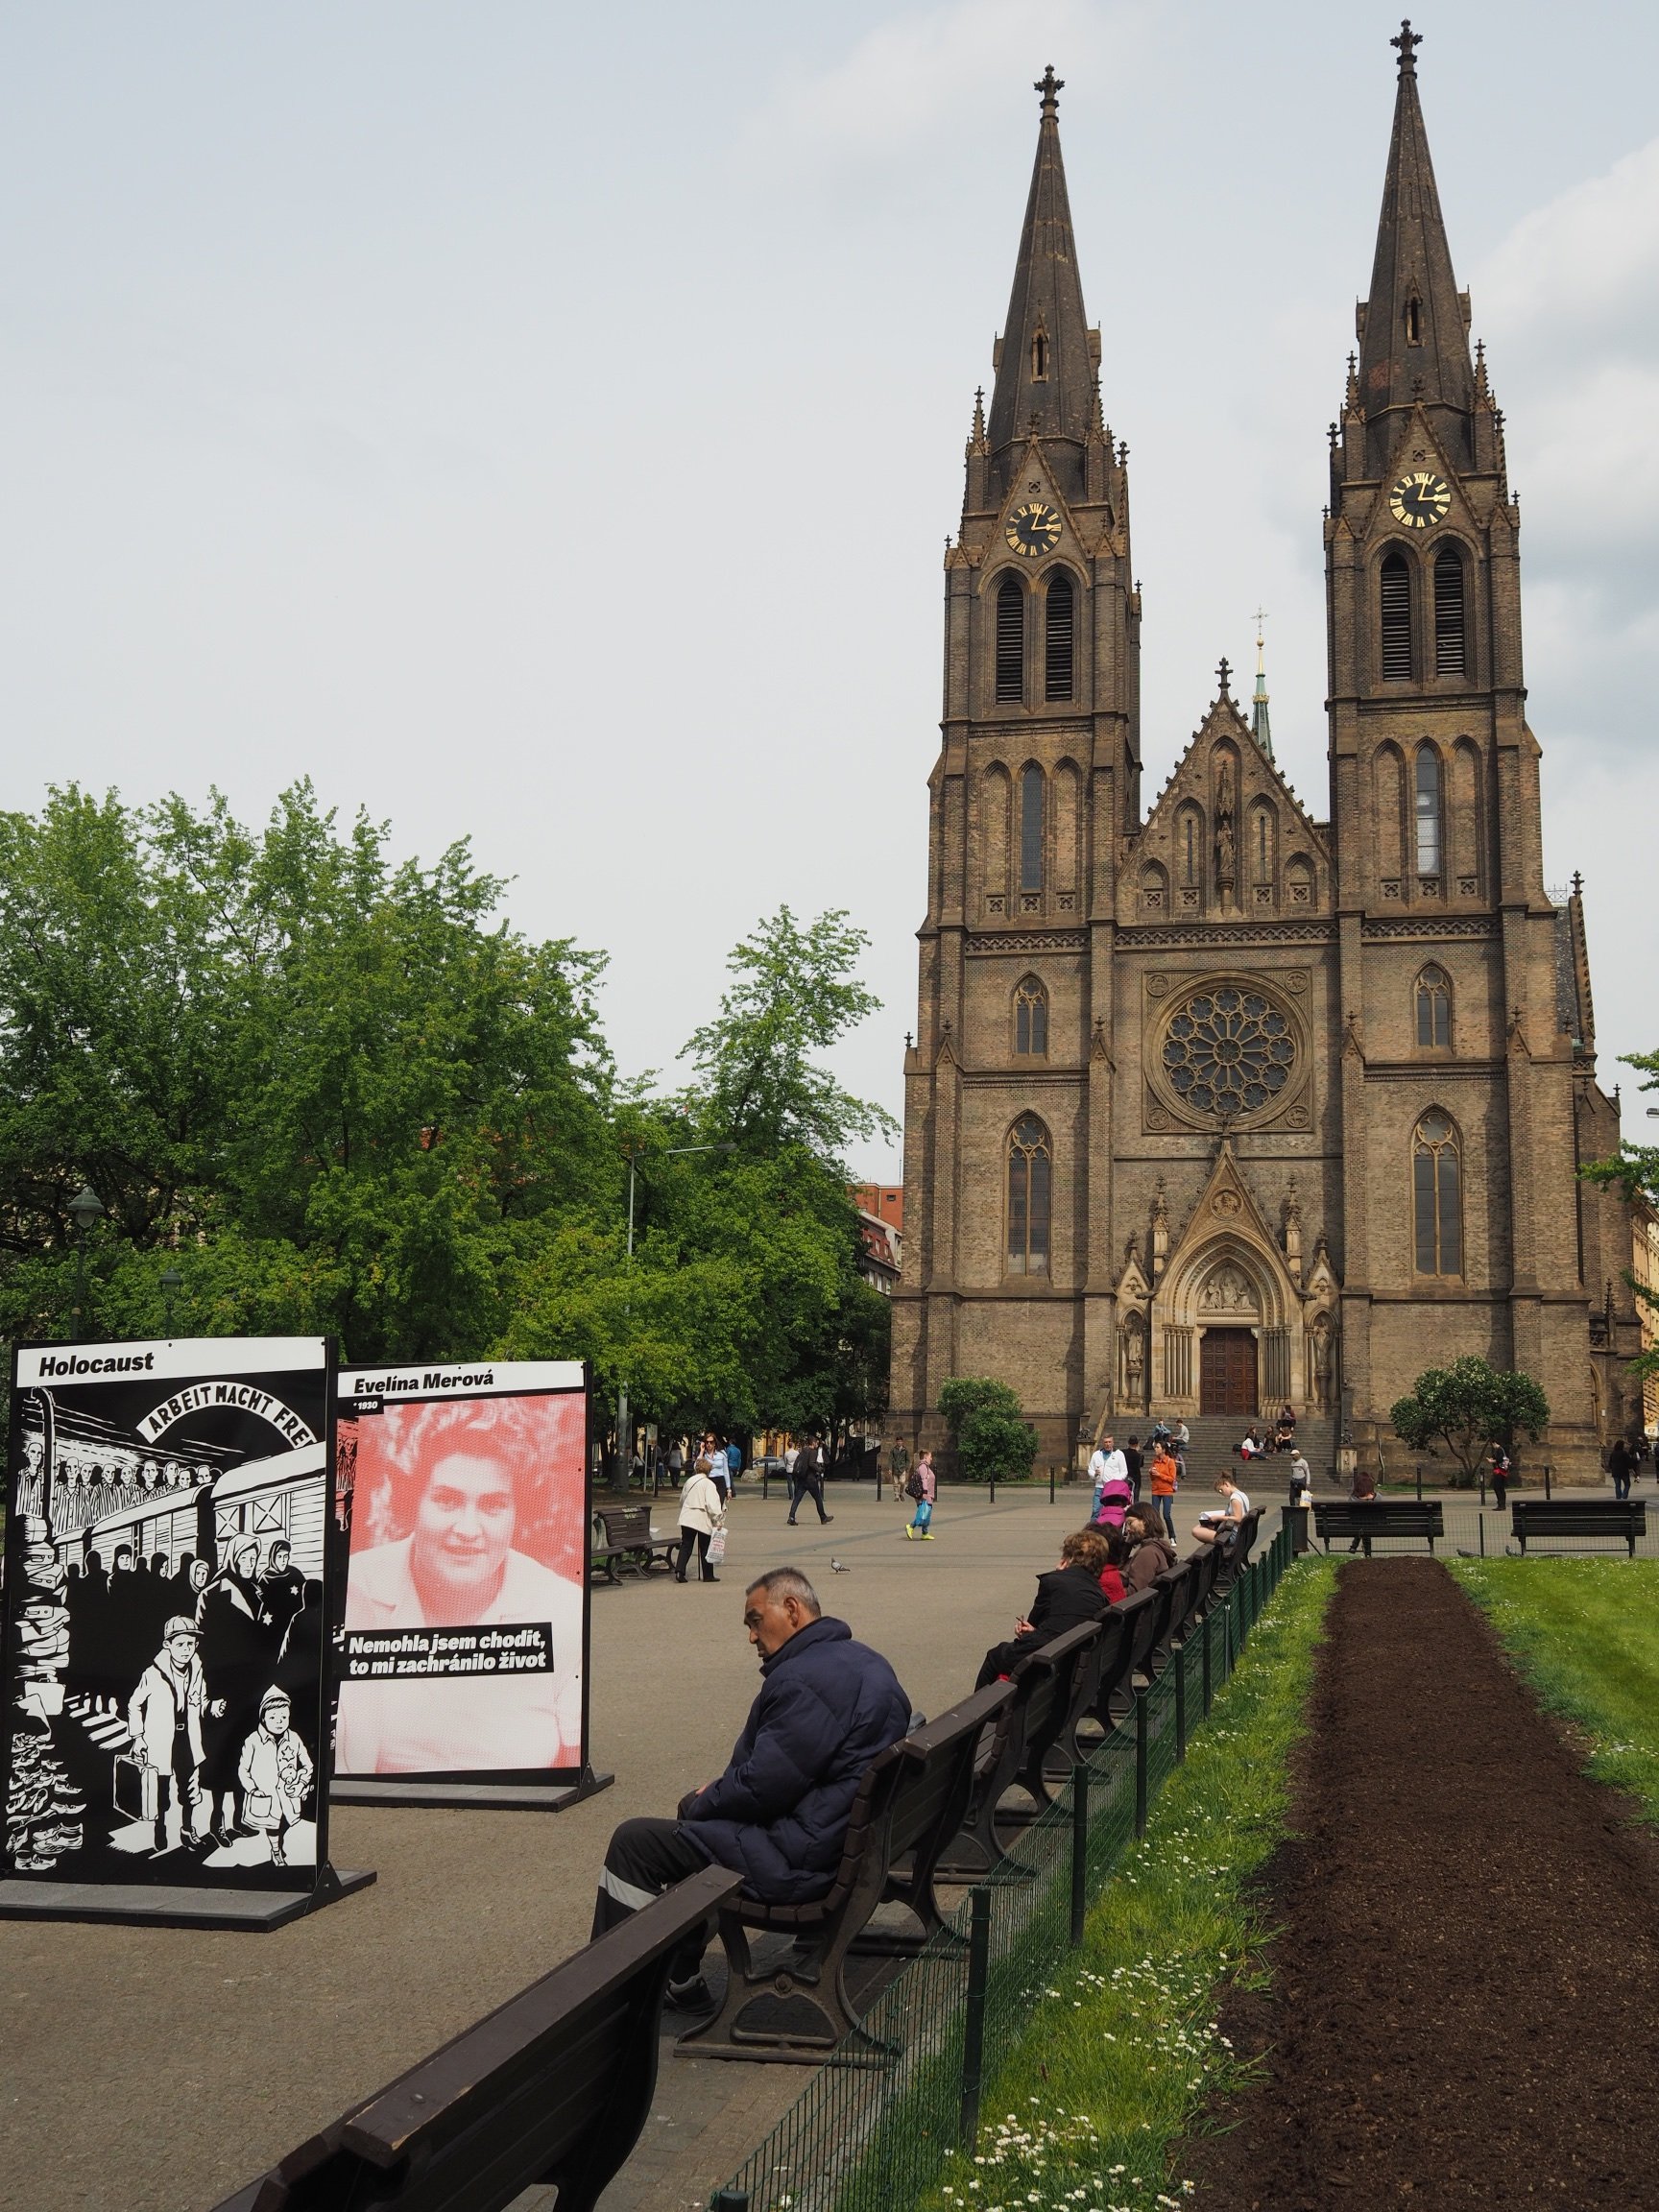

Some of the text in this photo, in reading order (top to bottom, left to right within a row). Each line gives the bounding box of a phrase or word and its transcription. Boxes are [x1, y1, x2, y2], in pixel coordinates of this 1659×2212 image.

[39, 1352, 154, 1377] Holocaust
[354, 1369, 493, 1394] Evelína Merová
[148, 1385, 211, 1433] ARBEIT
[215, 1384, 274, 1414] MACHT
[349, 1630, 546, 1654] Nemohla jsem chodit,
[349, 1651, 546, 1674] to mi zachránilo život
